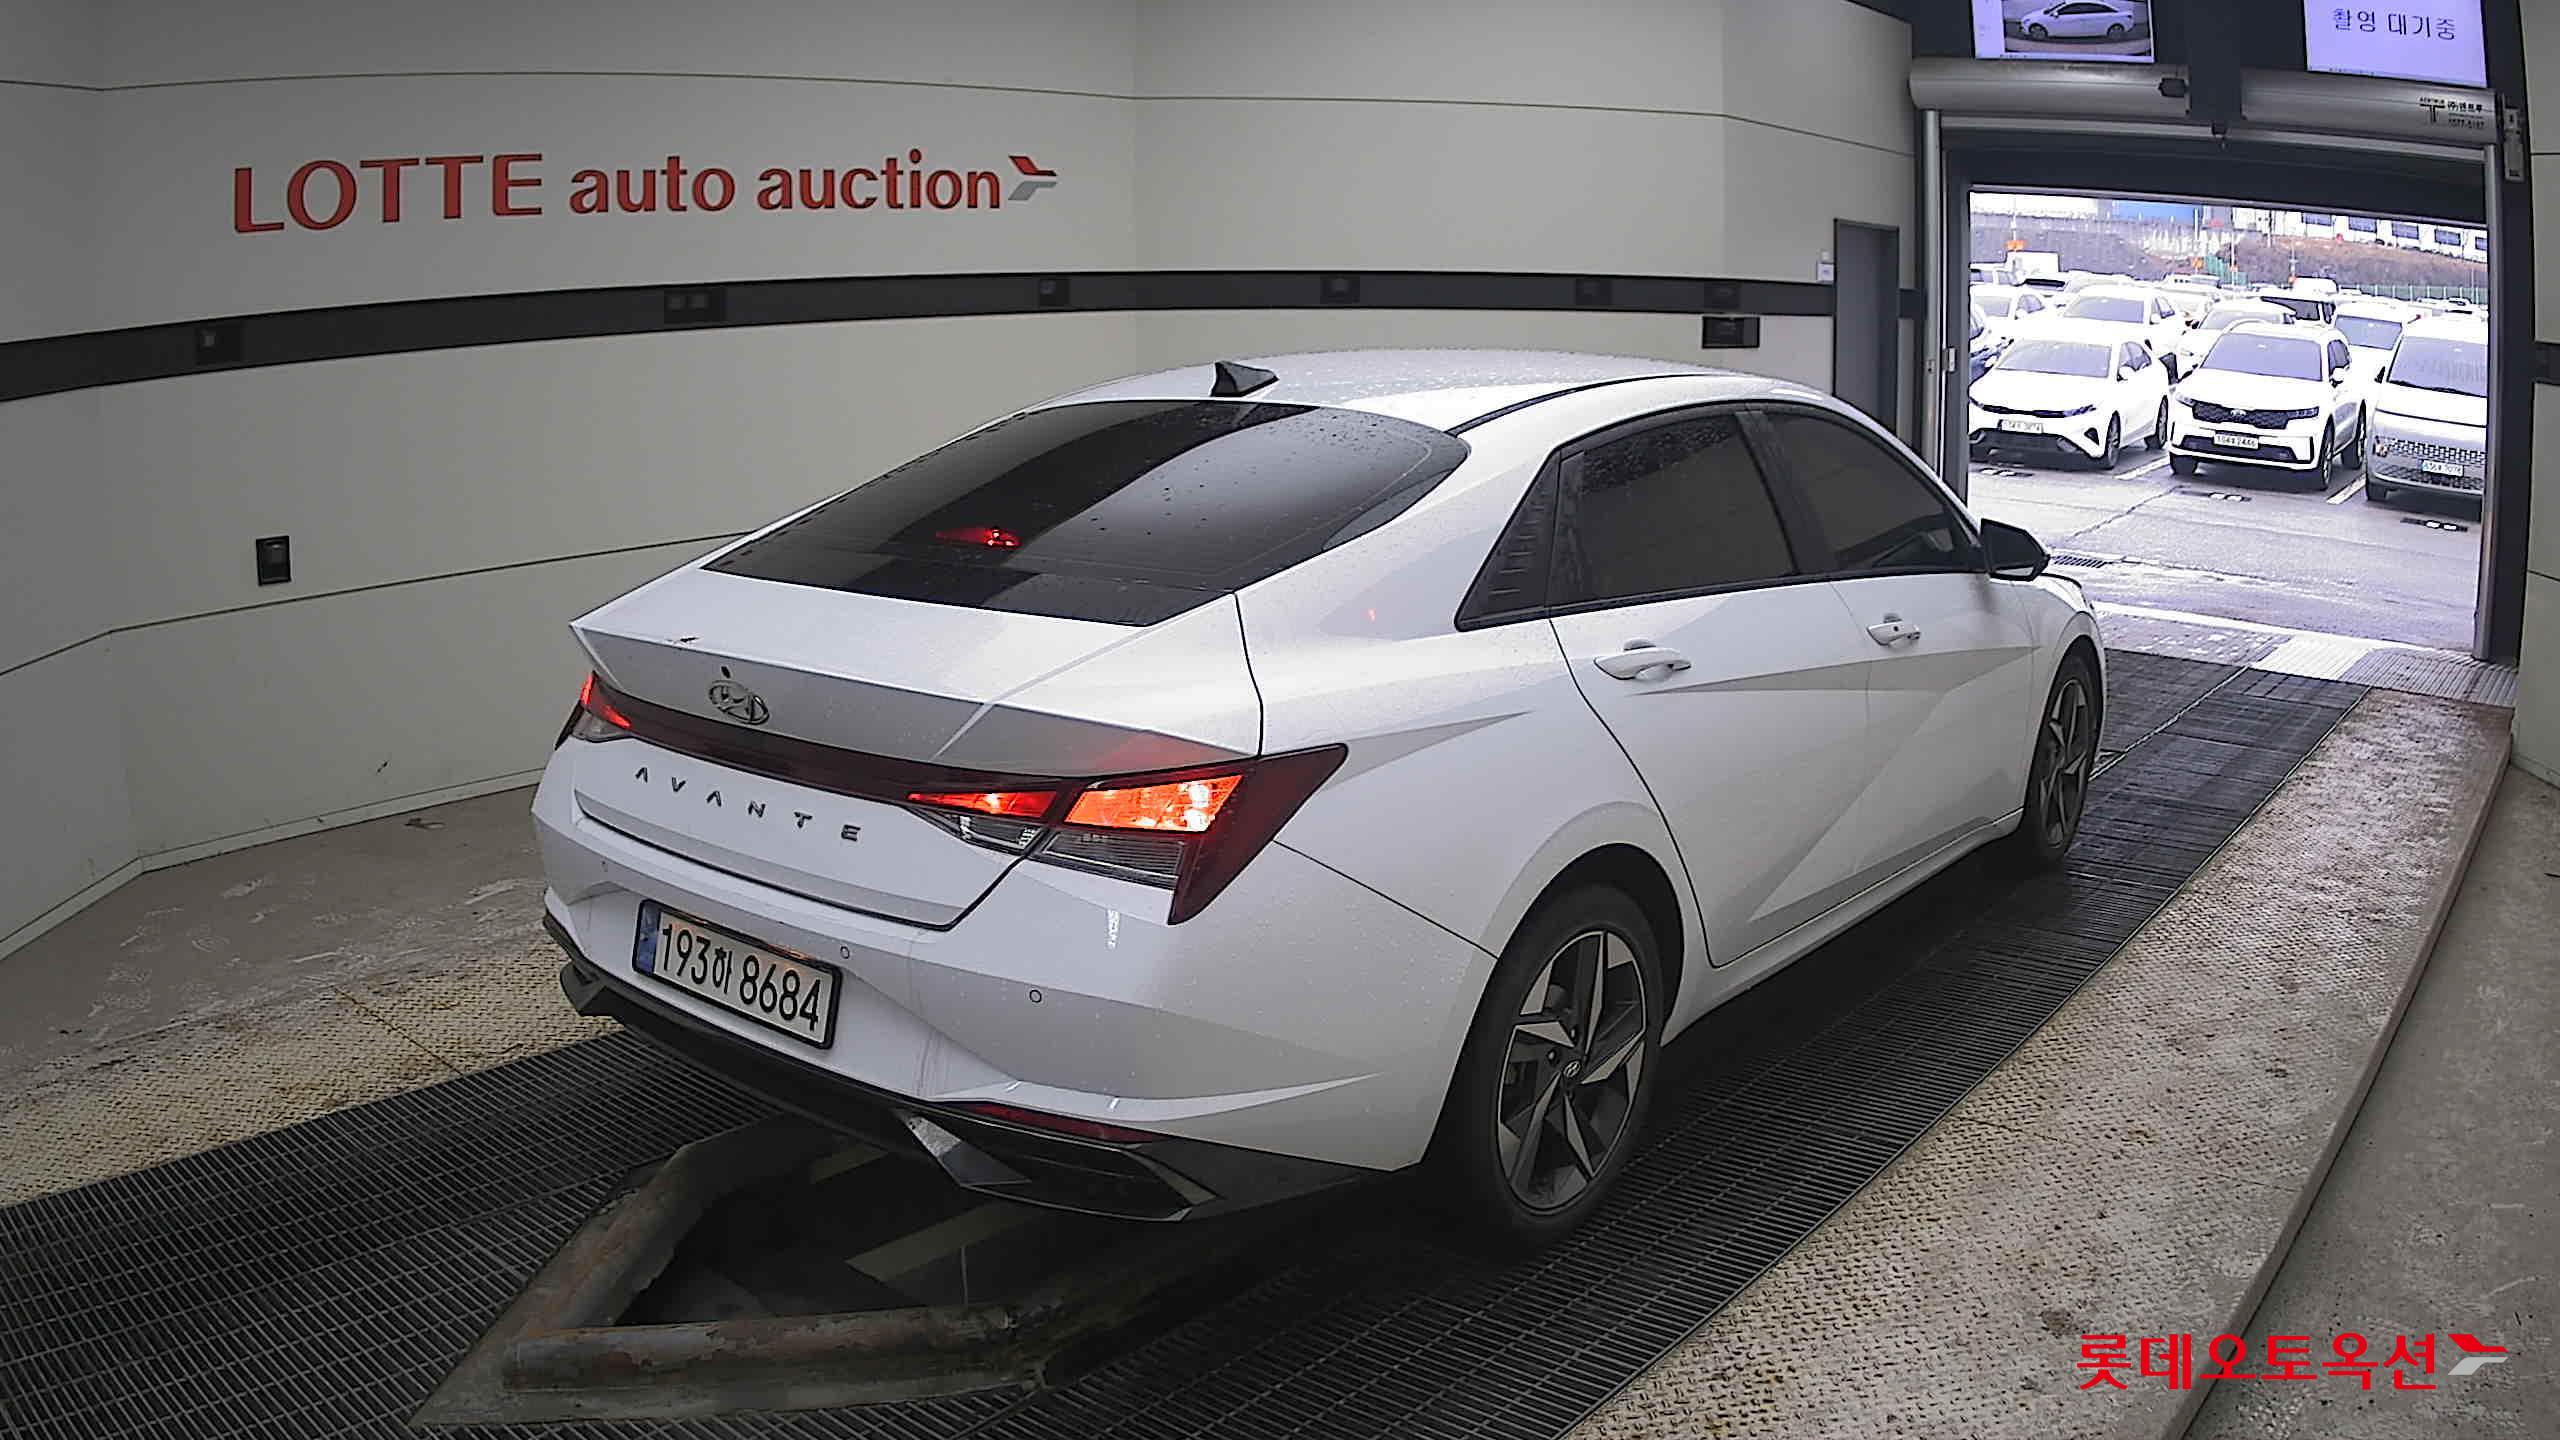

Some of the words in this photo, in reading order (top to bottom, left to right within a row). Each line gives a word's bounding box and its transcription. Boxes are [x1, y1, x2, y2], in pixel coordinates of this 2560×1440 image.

[2333, 8, 2377, 33] 촬영
[2387, 12, 2456, 41] 대기중
[234, 153, 543, 233] LOTTE
[568, 155, 736, 215] auto
[756, 148, 1001, 212] auction
[634, 765, 862, 843] AVANTE
[662, 923, 733, 995] 193하
[739, 954, 822, 1033] 8684
